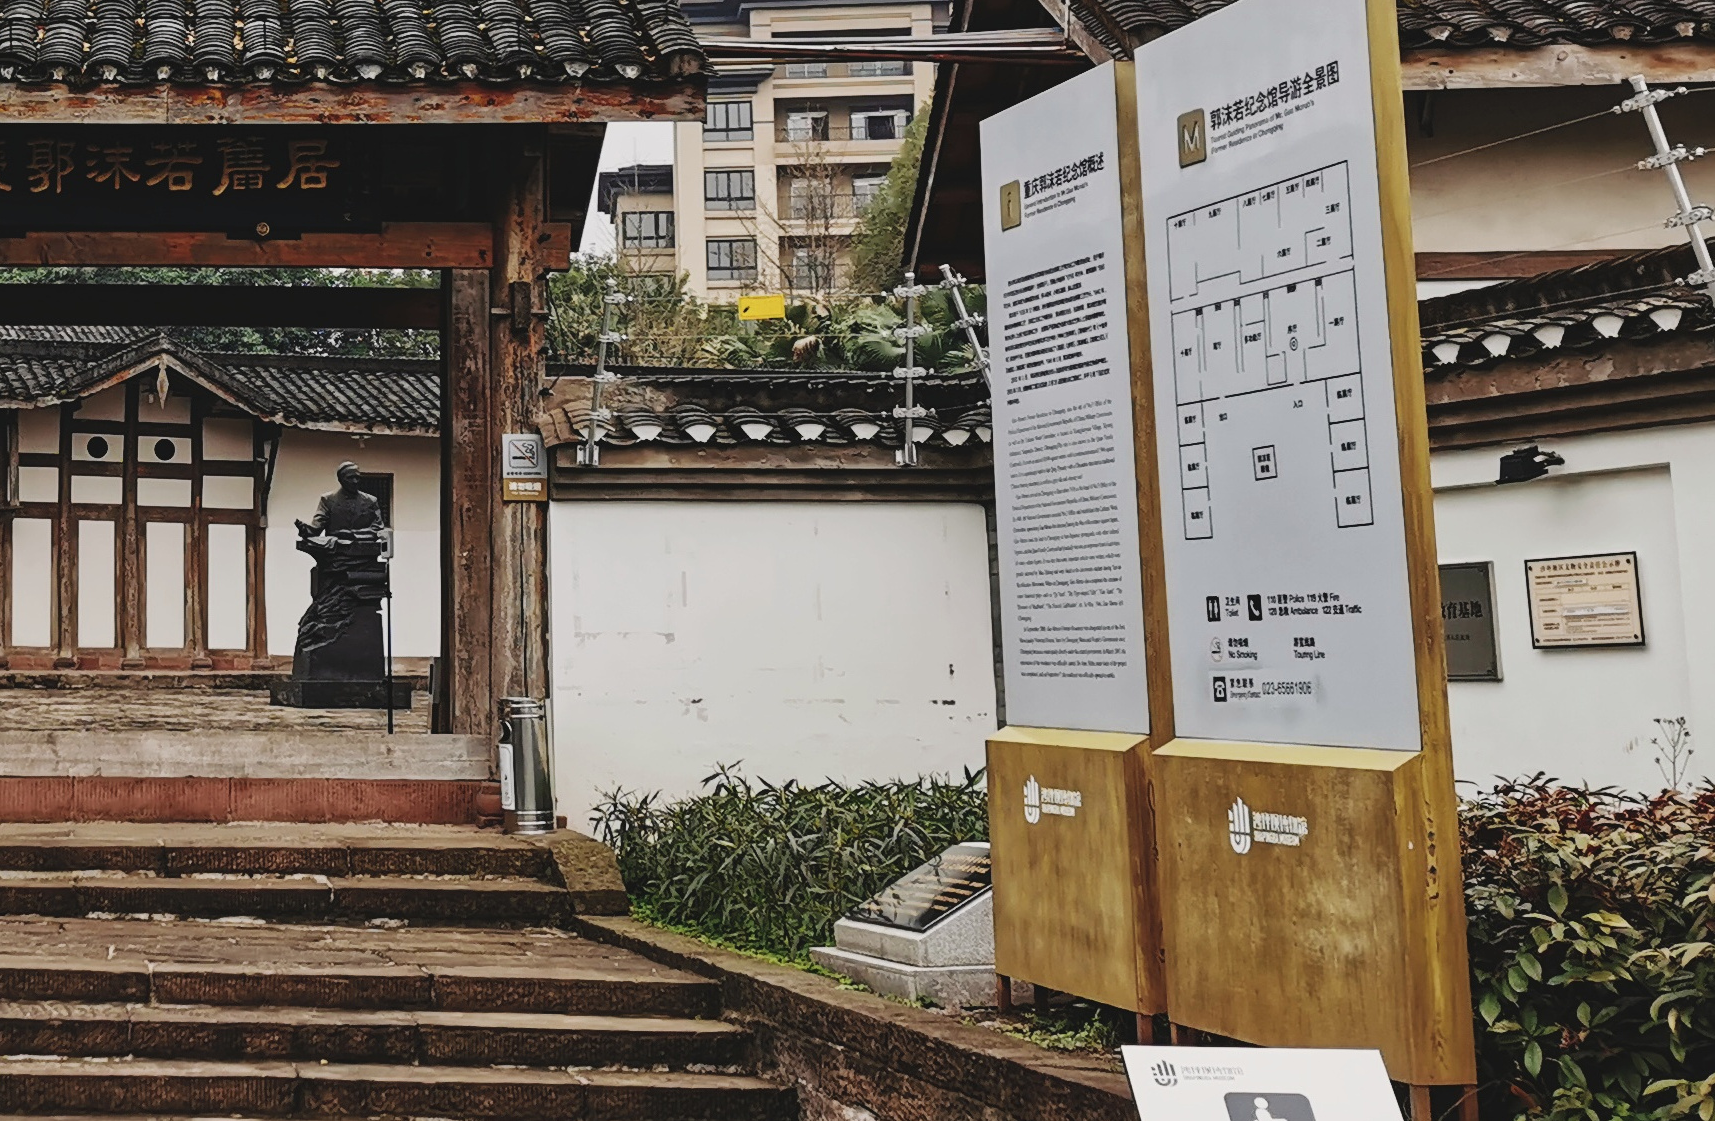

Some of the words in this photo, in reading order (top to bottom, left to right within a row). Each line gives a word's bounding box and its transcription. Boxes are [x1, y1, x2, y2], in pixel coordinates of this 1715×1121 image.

[1210, 60, 1339, 131] 郭沫若纪念馆导游全景图
[1024, 151, 1105, 199] 重庆郭沫若纪念馆概述
[1236, 650, 1257, 661] Smoking
[1293, 649, 1313, 661] Touring
